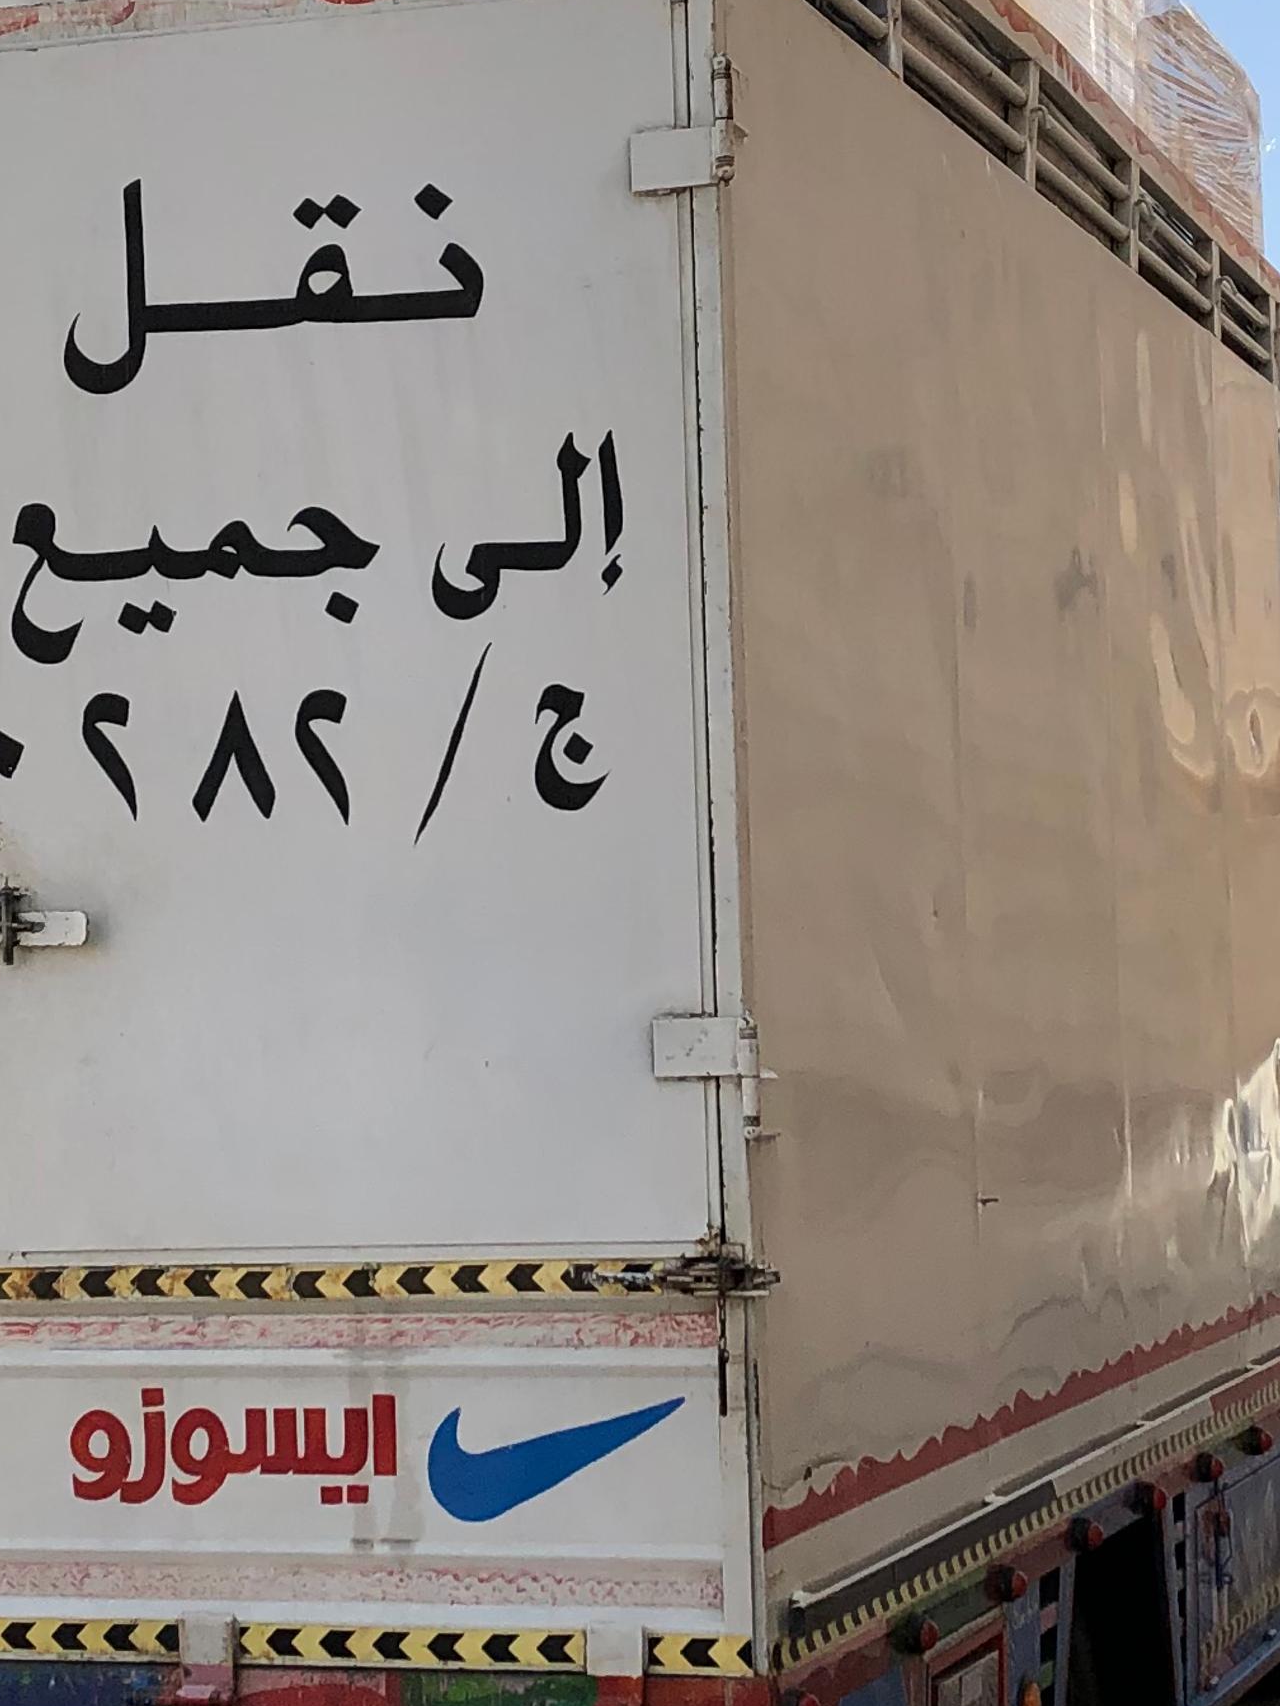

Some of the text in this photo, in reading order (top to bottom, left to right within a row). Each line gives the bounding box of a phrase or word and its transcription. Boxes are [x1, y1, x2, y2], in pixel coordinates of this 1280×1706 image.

[63, 178, 484, 395] نقل
[11, 503, 381, 665] جميع
[431, 429, 624, 621] إلى
[70, 1388, 397, 1505] ايسوزو
